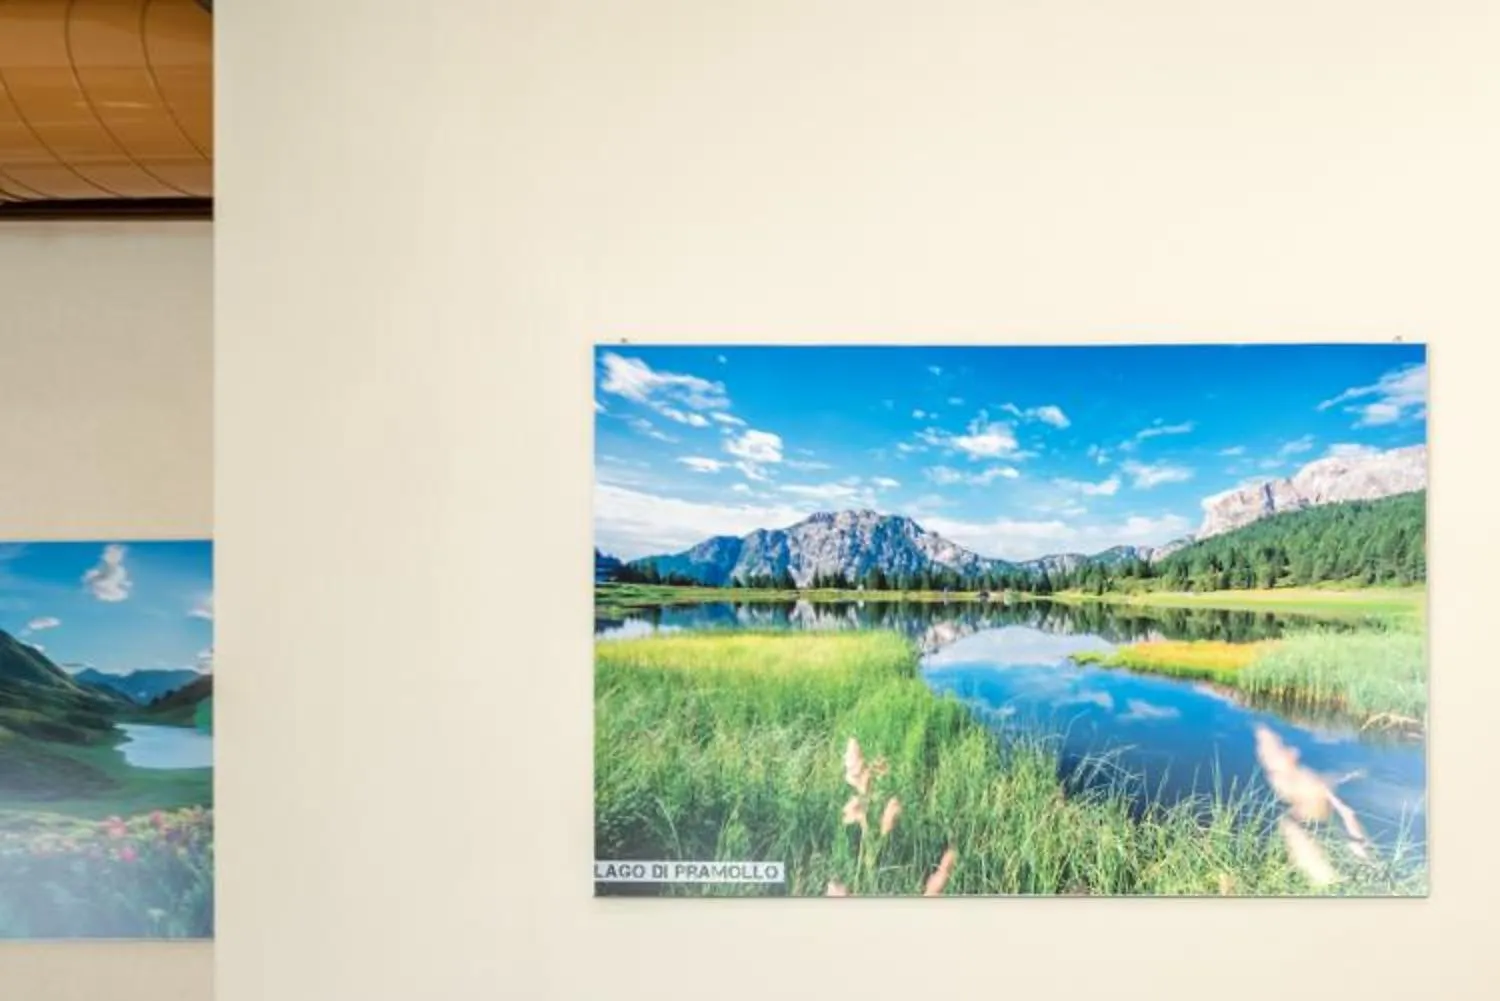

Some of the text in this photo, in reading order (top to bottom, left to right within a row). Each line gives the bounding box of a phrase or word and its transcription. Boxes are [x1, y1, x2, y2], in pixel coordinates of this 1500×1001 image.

[594, 864, 779, 880] LAGO DI PRAMOLLO
